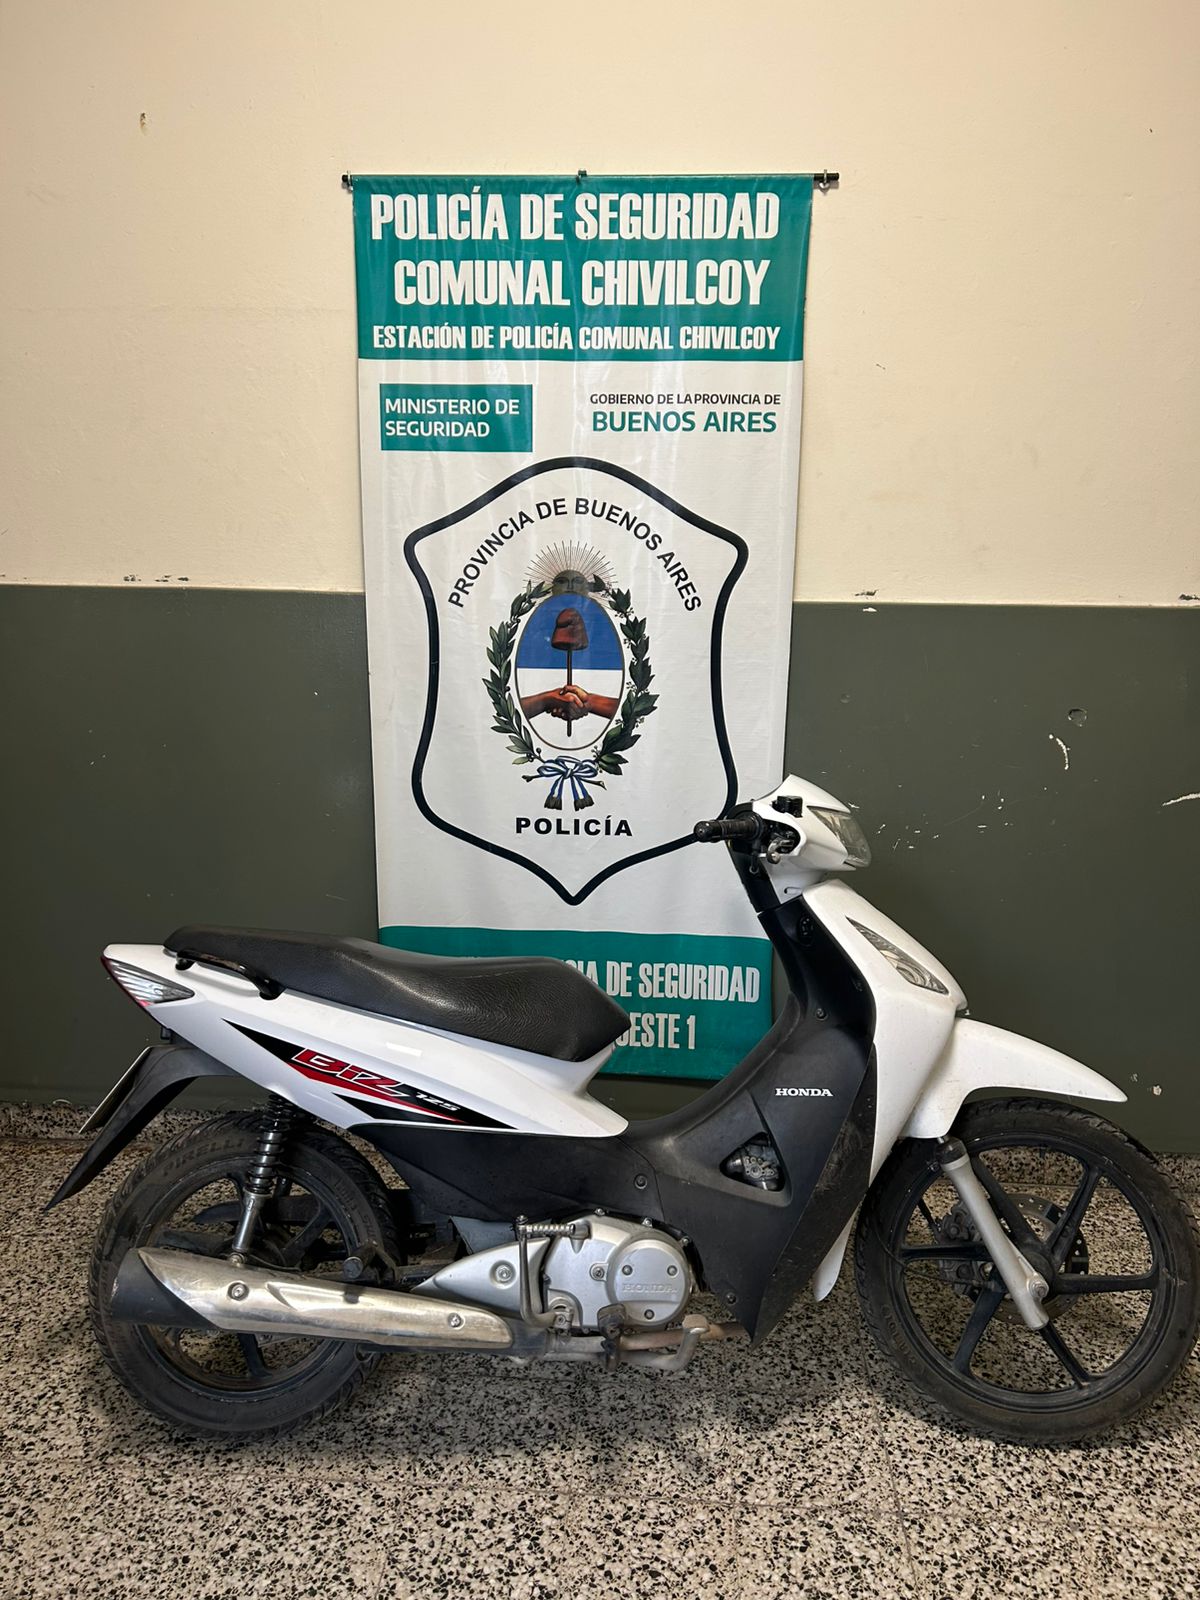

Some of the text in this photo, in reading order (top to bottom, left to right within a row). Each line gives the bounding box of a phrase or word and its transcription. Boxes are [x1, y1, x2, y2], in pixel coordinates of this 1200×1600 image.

[370, 186, 781, 241] POLICÍA DE SEGURIDAD
[394, 258, 771, 306] COMUNAL CHIVILCOY
[373, 322, 781, 351] ESTACIÓN DE POLICÍA COMUNAL CHIVILCOY
[385, 399, 520, 415] MINISTERIO DE
[590, 393, 654, 405] GOBIERNO
[657, 393, 674, 405] DE
[764, 393, 781, 405] DE
[385, 420, 490, 438] SEGURIDAD
[592, 411, 777, 433] BUENOS AIRES
[448, 497, 703, 613] PROVINCIA DE BUENOS AIRES
[515, 814, 633, 836] POLICÍA
[606, 961, 633, 997] DE
[638, 963, 760, 1003] SEGURIDAD
[686, 1015, 696, 1050] 1
[415, 1091, 460, 1112] 125
[775, 1087, 834, 1097] HONDA
[622, 1282, 678, 1294] HONDA
